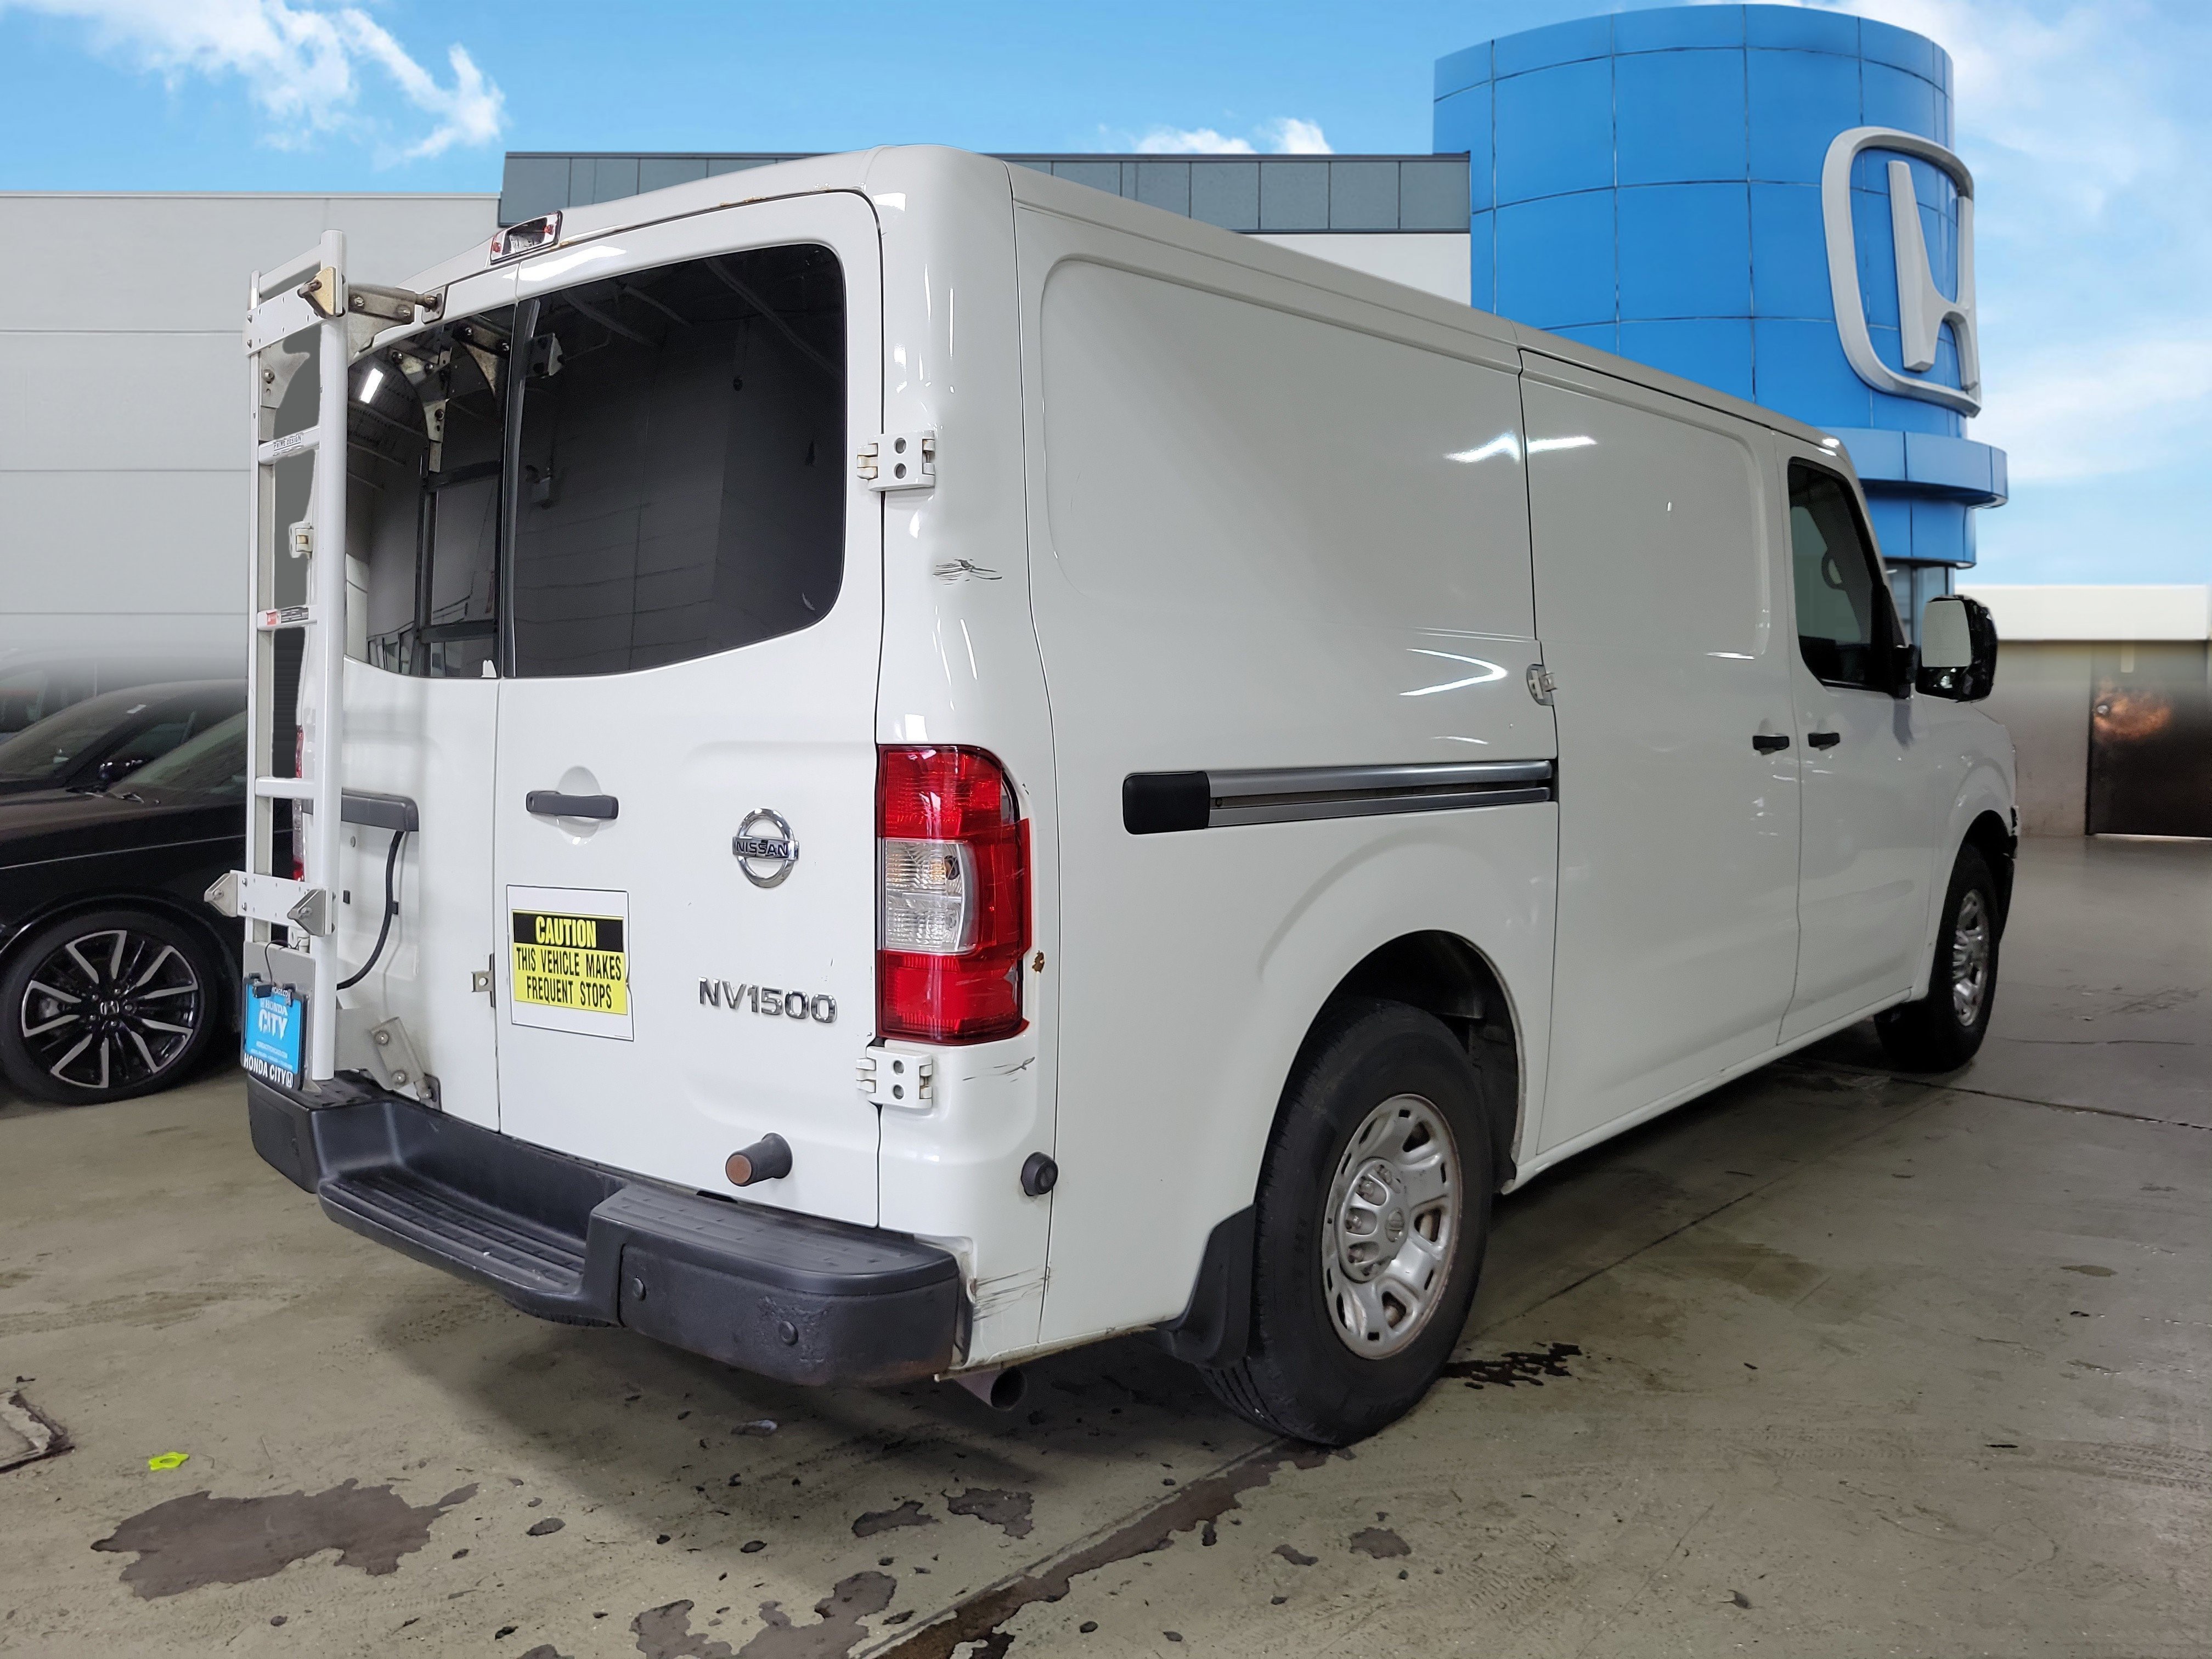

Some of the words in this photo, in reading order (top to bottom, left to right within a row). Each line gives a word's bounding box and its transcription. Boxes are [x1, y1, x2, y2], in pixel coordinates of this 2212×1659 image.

[286, 434, 301, 445] DESIGN
[736, 840, 788, 856] NISSAN
[535, 916, 596, 949] CAUTION
[516, 947, 536, 972] THIS
[541, 949, 580, 976] VEHICLE
[585, 953, 622, 981] MAKES
[266, 999, 288, 1015] HONDA
[527, 975, 573, 1004] FREQUENT
[580, 983, 612, 1009] STOPS
[698, 977, 838, 1023] NV1500
[258, 1008, 289, 1040] CITY
[244, 1052, 268, 1077] HONDA
[269, 1064, 286, 1086] CITY
